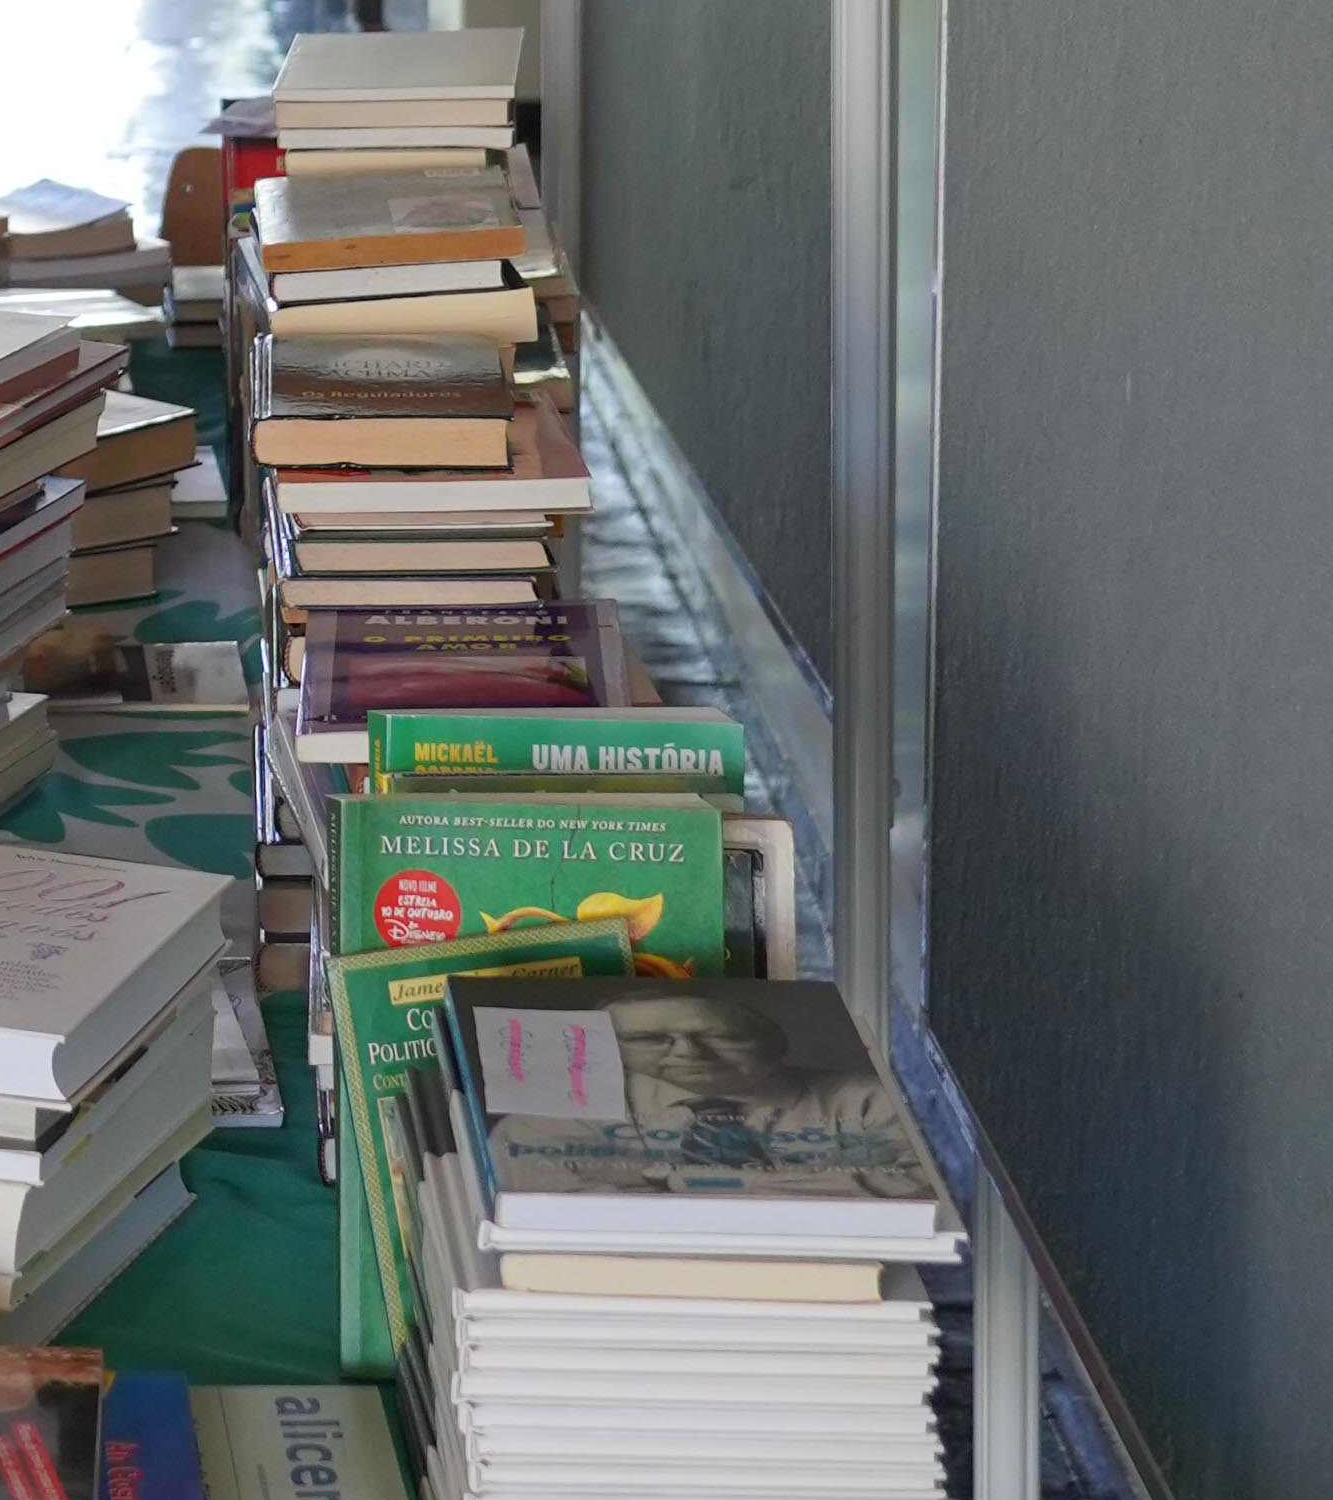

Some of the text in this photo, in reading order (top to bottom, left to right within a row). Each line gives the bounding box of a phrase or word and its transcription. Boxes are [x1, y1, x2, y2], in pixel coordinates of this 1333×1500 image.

[365, 614, 568, 626] ALBERONI
[404, 633, 572, 643] PRIMEIRO
[416, 642, 518, 651] AMOR
[413, 741, 500, 765] MICKAËL
[532, 742, 724, 776] UMA HISTÓRIA
[399, 814, 667, 833] AUTORA BEST-SELLER DO NEW YORK TIMES
[380, 834, 686, 864] MELISSA DE LA CRUZ
[407, 907, 454, 921] OUTUBRO
[392, 981, 443, 1001] Jame
[406, 1007, 434, 1031] CO
[367, 1038, 437, 1065] POLITIC
[372, 1072, 406, 1091] CONT
